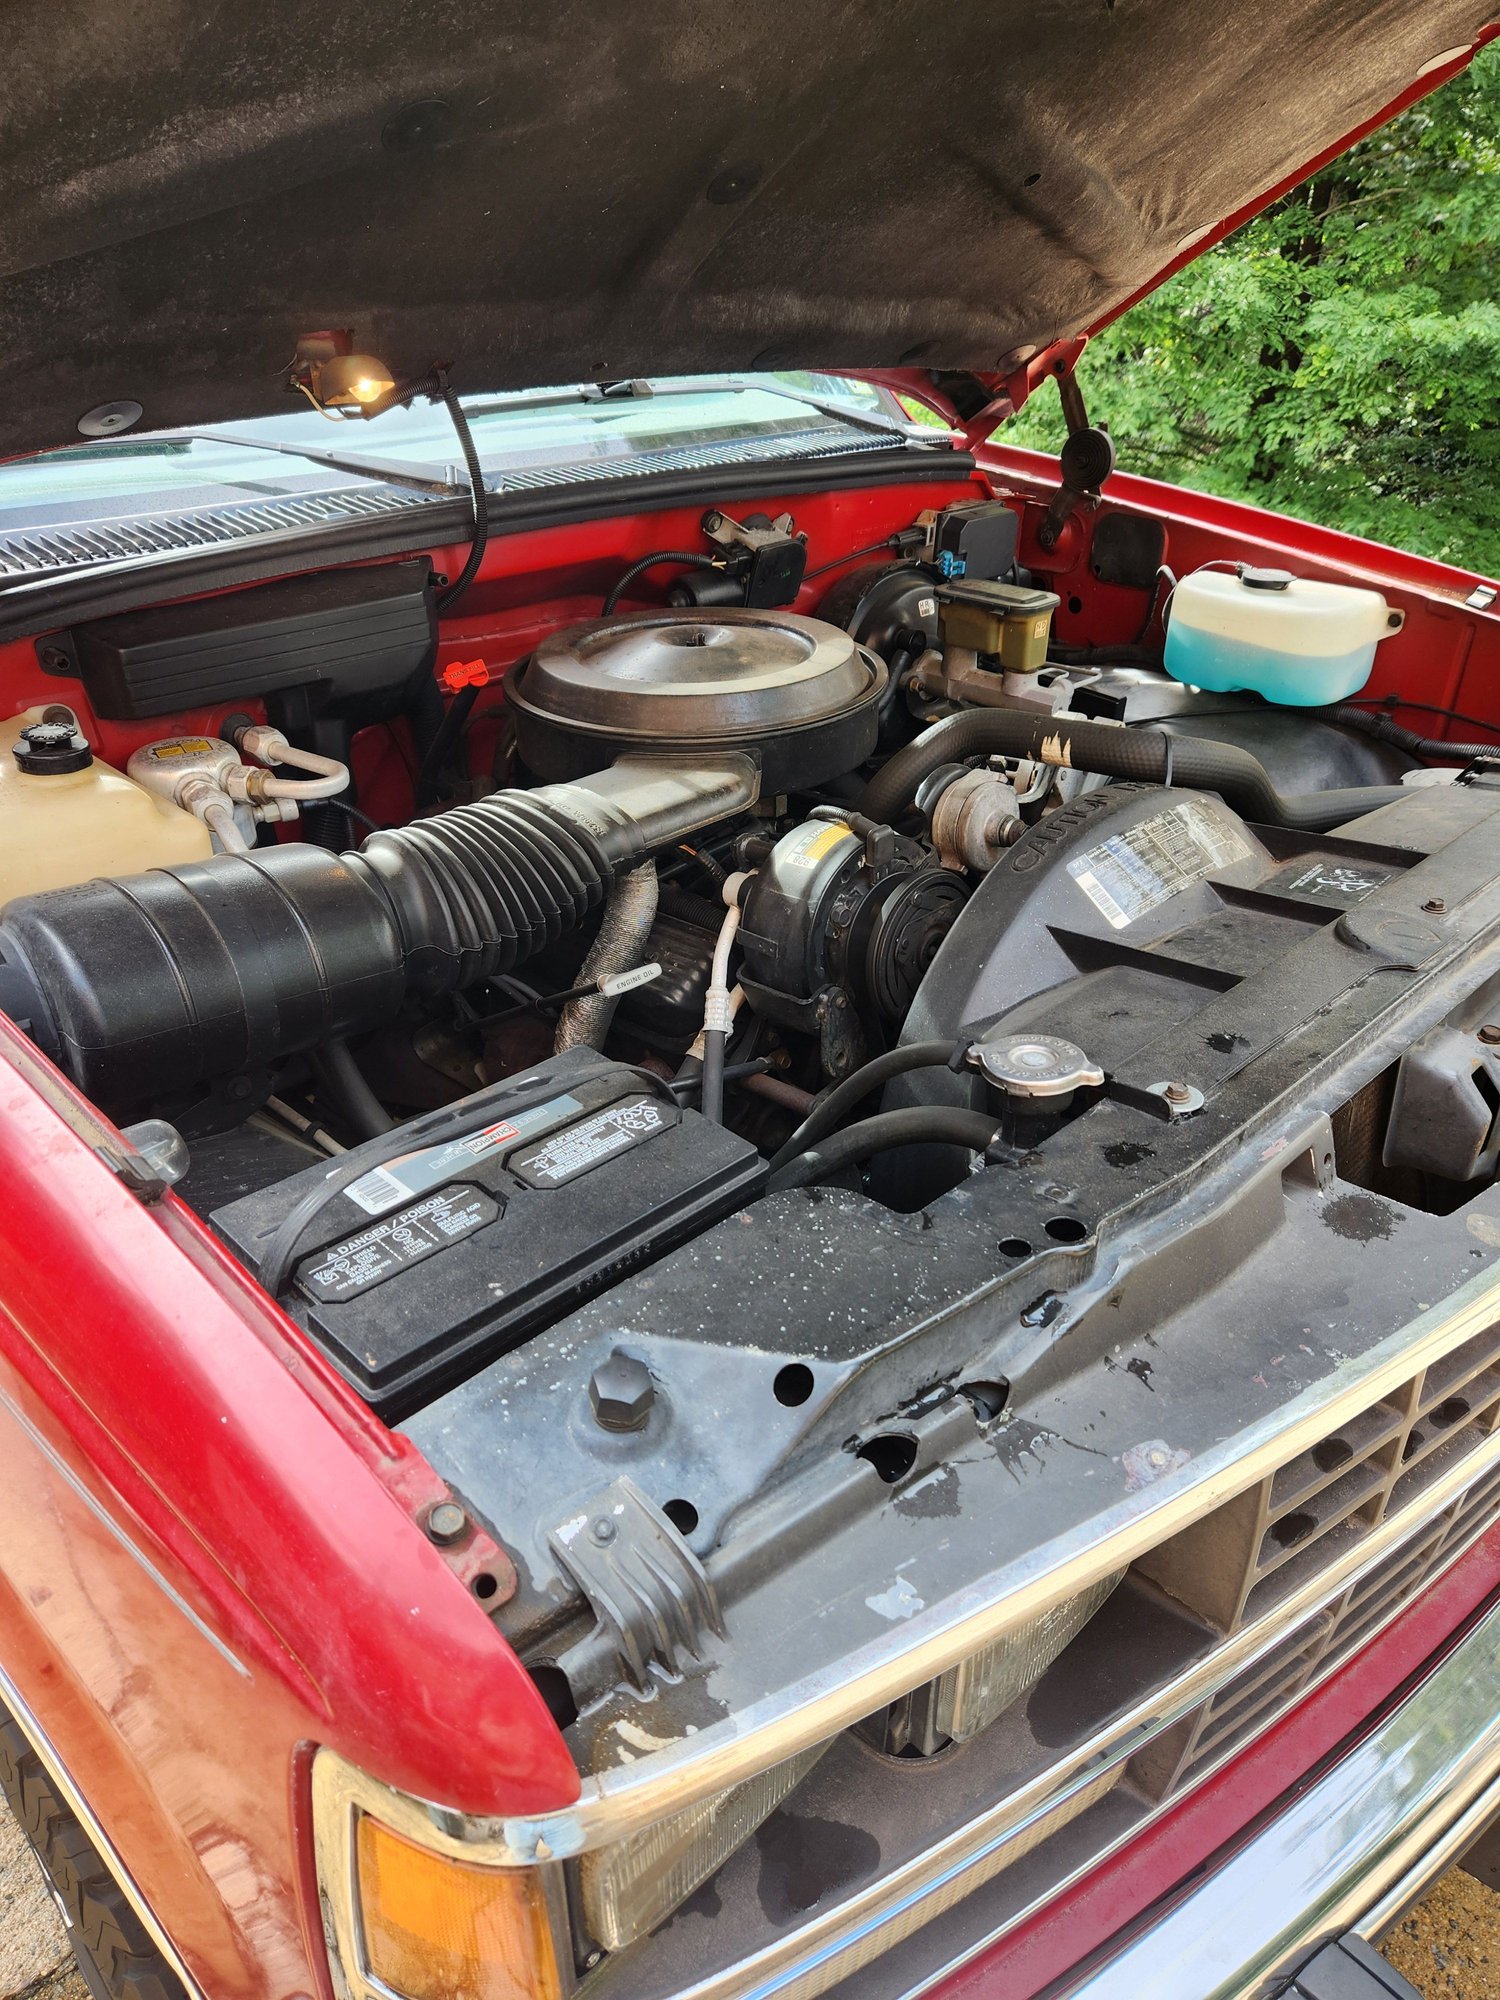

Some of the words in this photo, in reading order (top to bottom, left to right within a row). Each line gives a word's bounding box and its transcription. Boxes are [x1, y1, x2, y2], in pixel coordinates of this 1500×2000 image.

[1010, 794, 1108, 872] CAUTION
[616, 974, 642, 990] ENGINE
[643, 969, 655, 978] OIL
[467, 1125, 513, 1149] CHAMPION
[336, 1224, 391, 1254] DANGER
[398, 1196, 446, 1223] POISON
